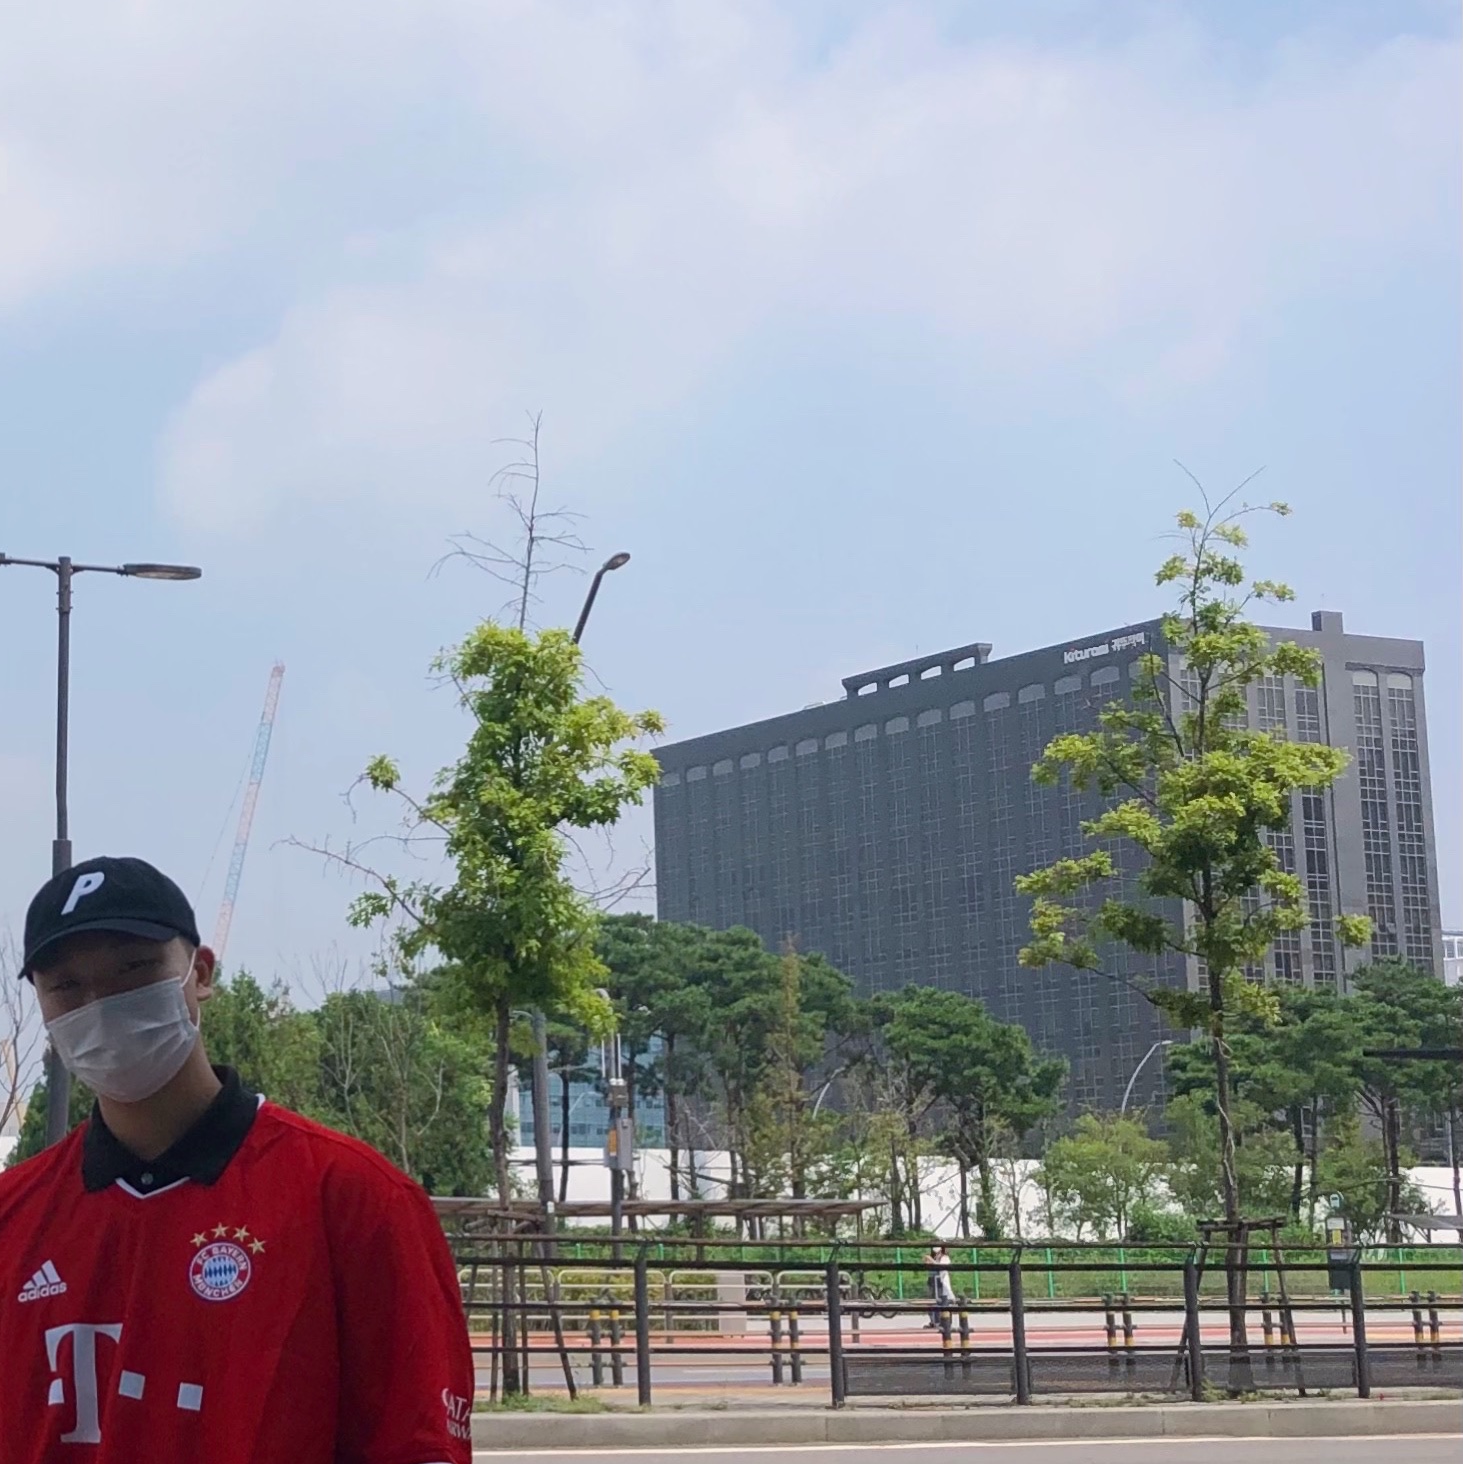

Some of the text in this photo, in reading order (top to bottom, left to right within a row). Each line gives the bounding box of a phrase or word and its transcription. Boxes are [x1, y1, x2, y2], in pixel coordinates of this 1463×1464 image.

[61, 871, 105, 916] P
[196, 1246, 248, 1271] FC BAYERN
[17, 1282, 68, 1303] adidas
